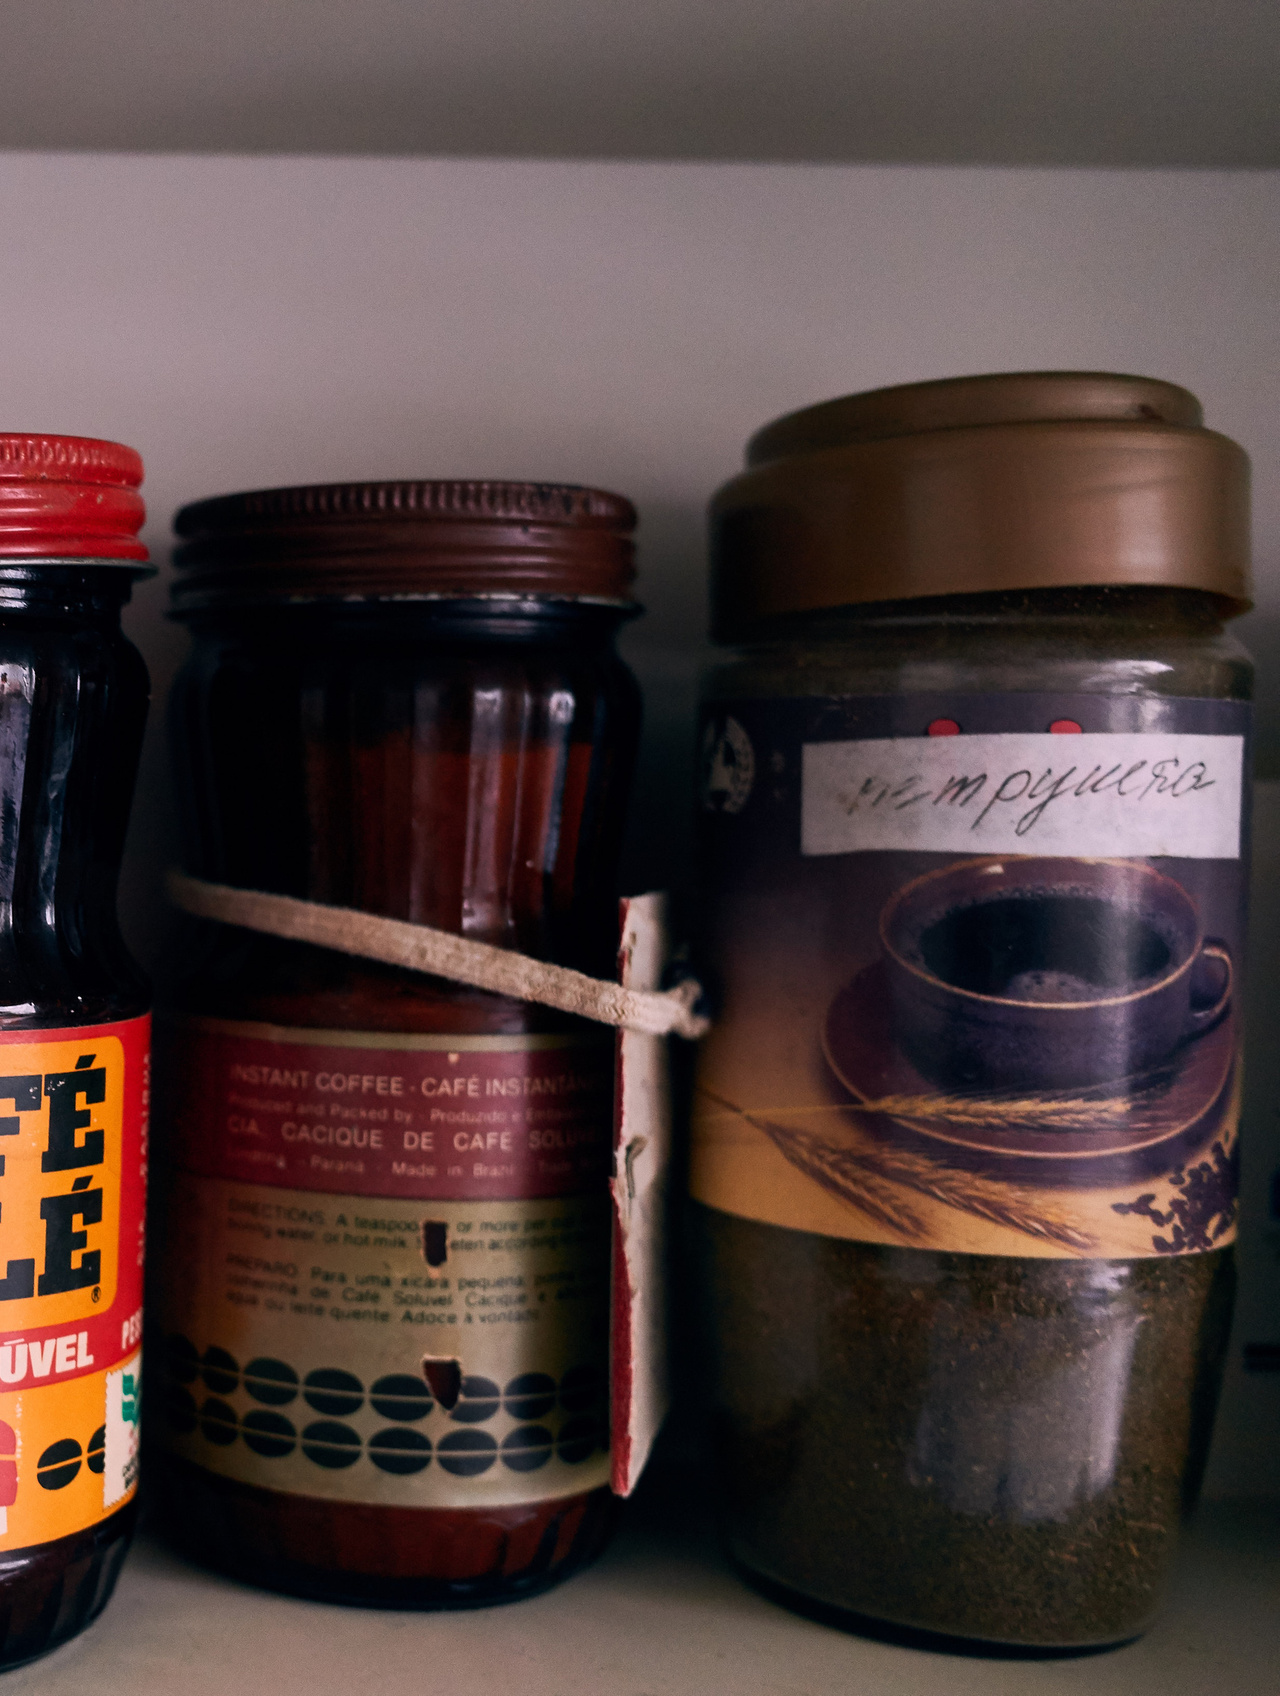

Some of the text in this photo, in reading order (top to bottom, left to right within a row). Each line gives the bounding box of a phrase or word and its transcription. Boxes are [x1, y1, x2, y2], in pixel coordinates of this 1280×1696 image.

[228, 1064, 310, 1089] INSTANT
[314, 1071, 406, 1097] COFFEE
[420, 1074, 482, 1098] CAFÉ
[329, 1103, 390, 1121] Packed
[393, 1108, 415, 1125] by
[280, 1121, 385, 1151] CACIQUE
[401, 1130, 436, 1152] DE
[452, 1128, 514, 1153] CAFÉ
[391, 1160, 438, 1178] Made
[354, 1216, 420, 1234] teaspoo
